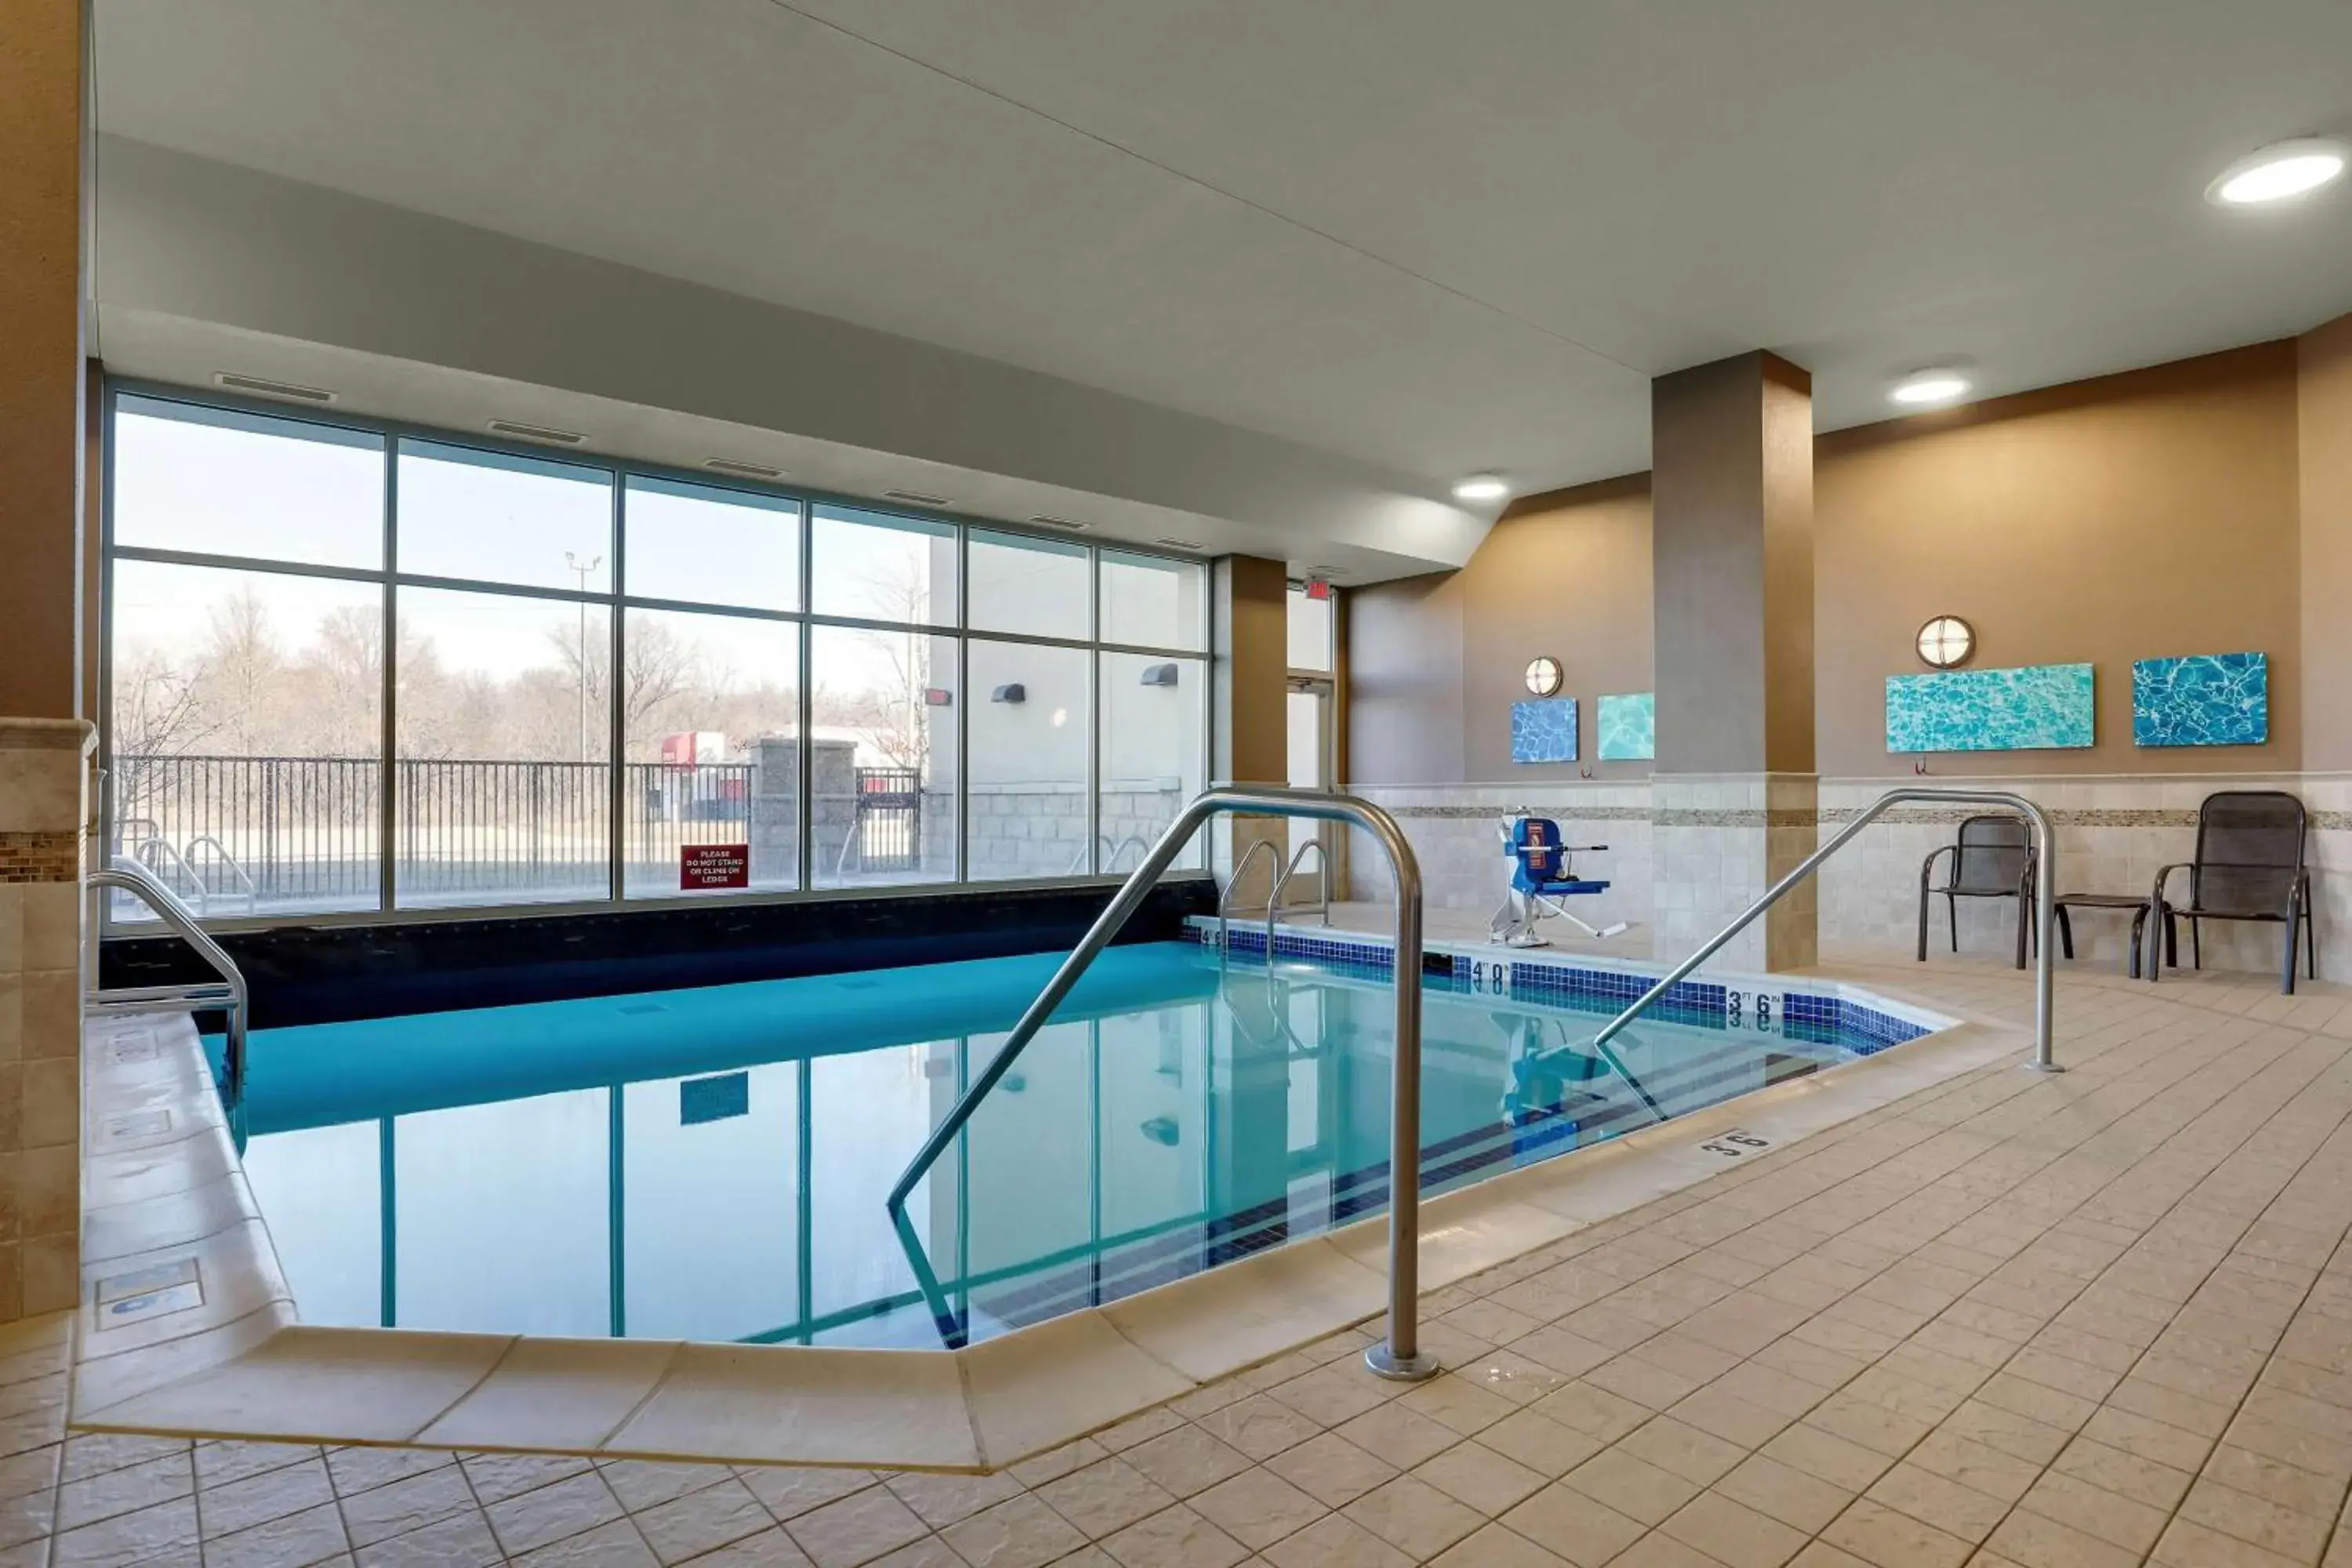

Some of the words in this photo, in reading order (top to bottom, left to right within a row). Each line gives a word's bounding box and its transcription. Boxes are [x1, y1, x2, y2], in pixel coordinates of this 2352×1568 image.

[1472, 961, 1483, 979] 4
[1729, 991, 1740, 1010] 3
[1757, 994, 1770, 1013] 6
